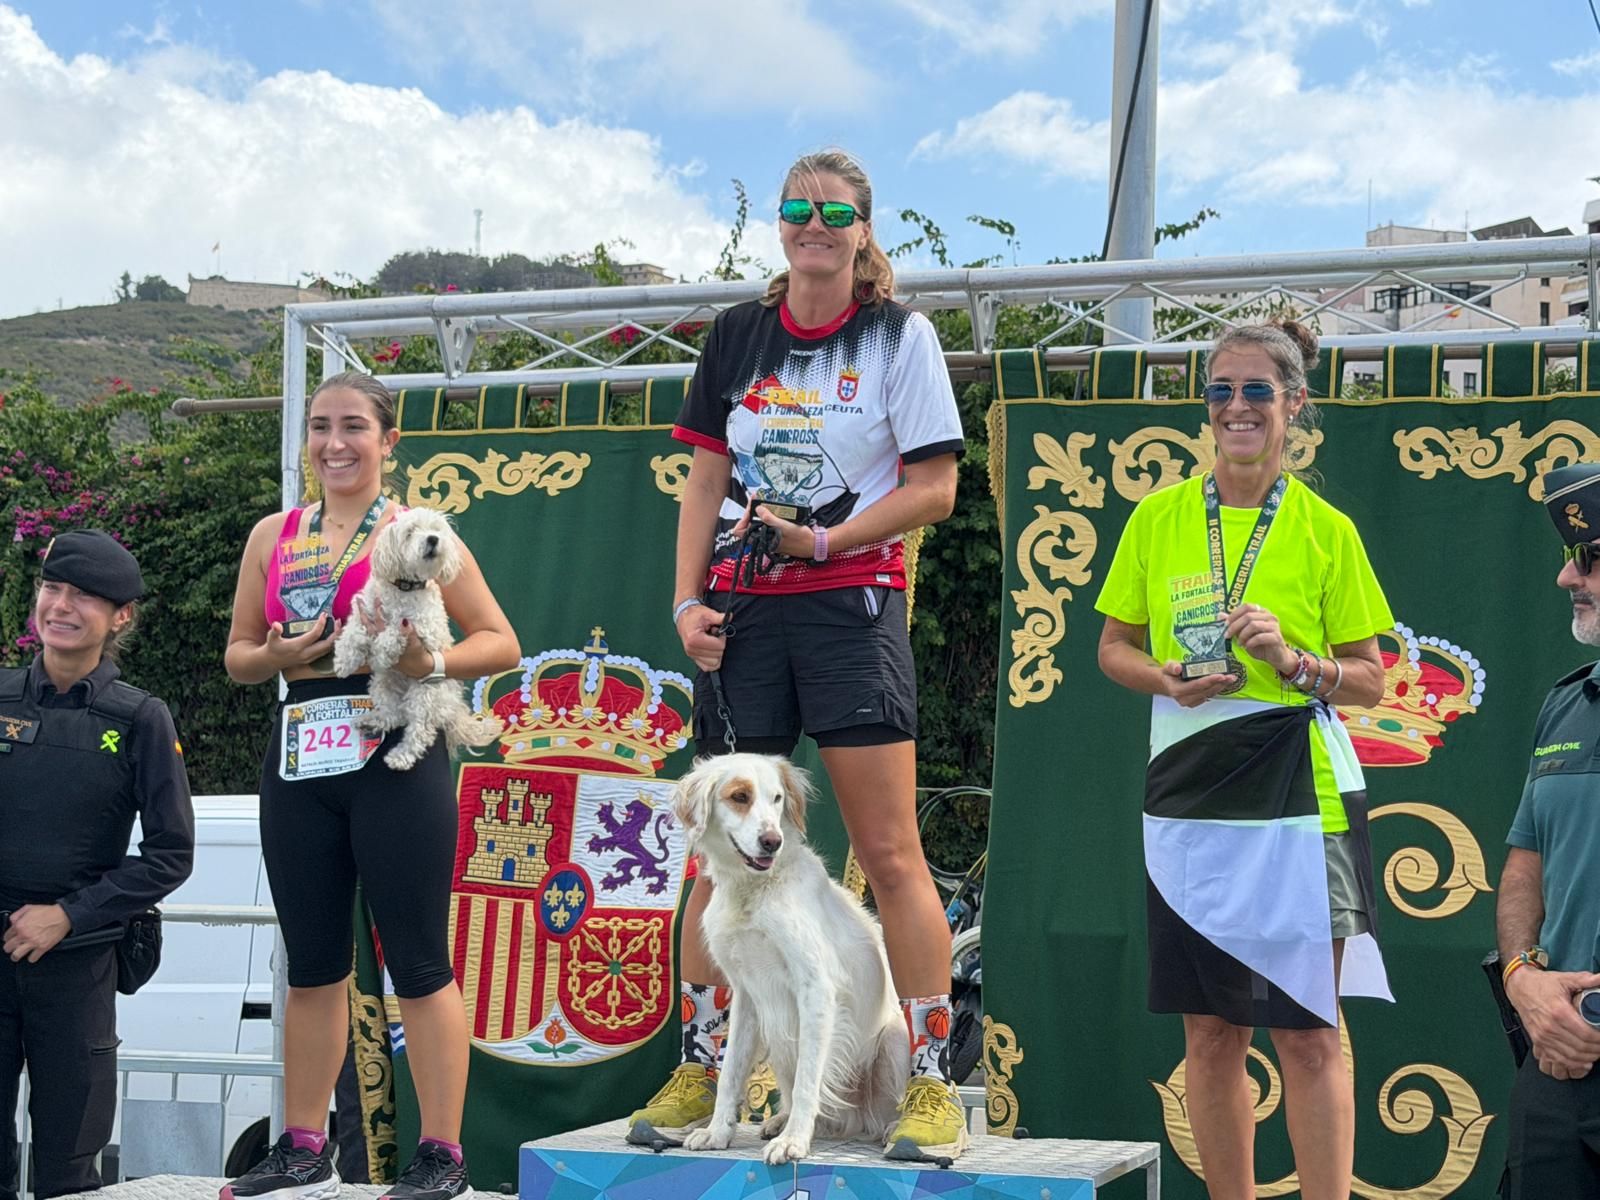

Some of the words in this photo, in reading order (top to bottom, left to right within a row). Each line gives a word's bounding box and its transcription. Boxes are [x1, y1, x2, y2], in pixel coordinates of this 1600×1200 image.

[824, 403, 863, 415] CEUTA
[1208, 518, 1219, 526] II
[1209, 527, 1224, 585] CORRERIAS
[1227, 553, 1255, 612] CORRERIAS
[1248, 524, 1268, 551] TRAIL
[304, 724, 352, 753] 242
